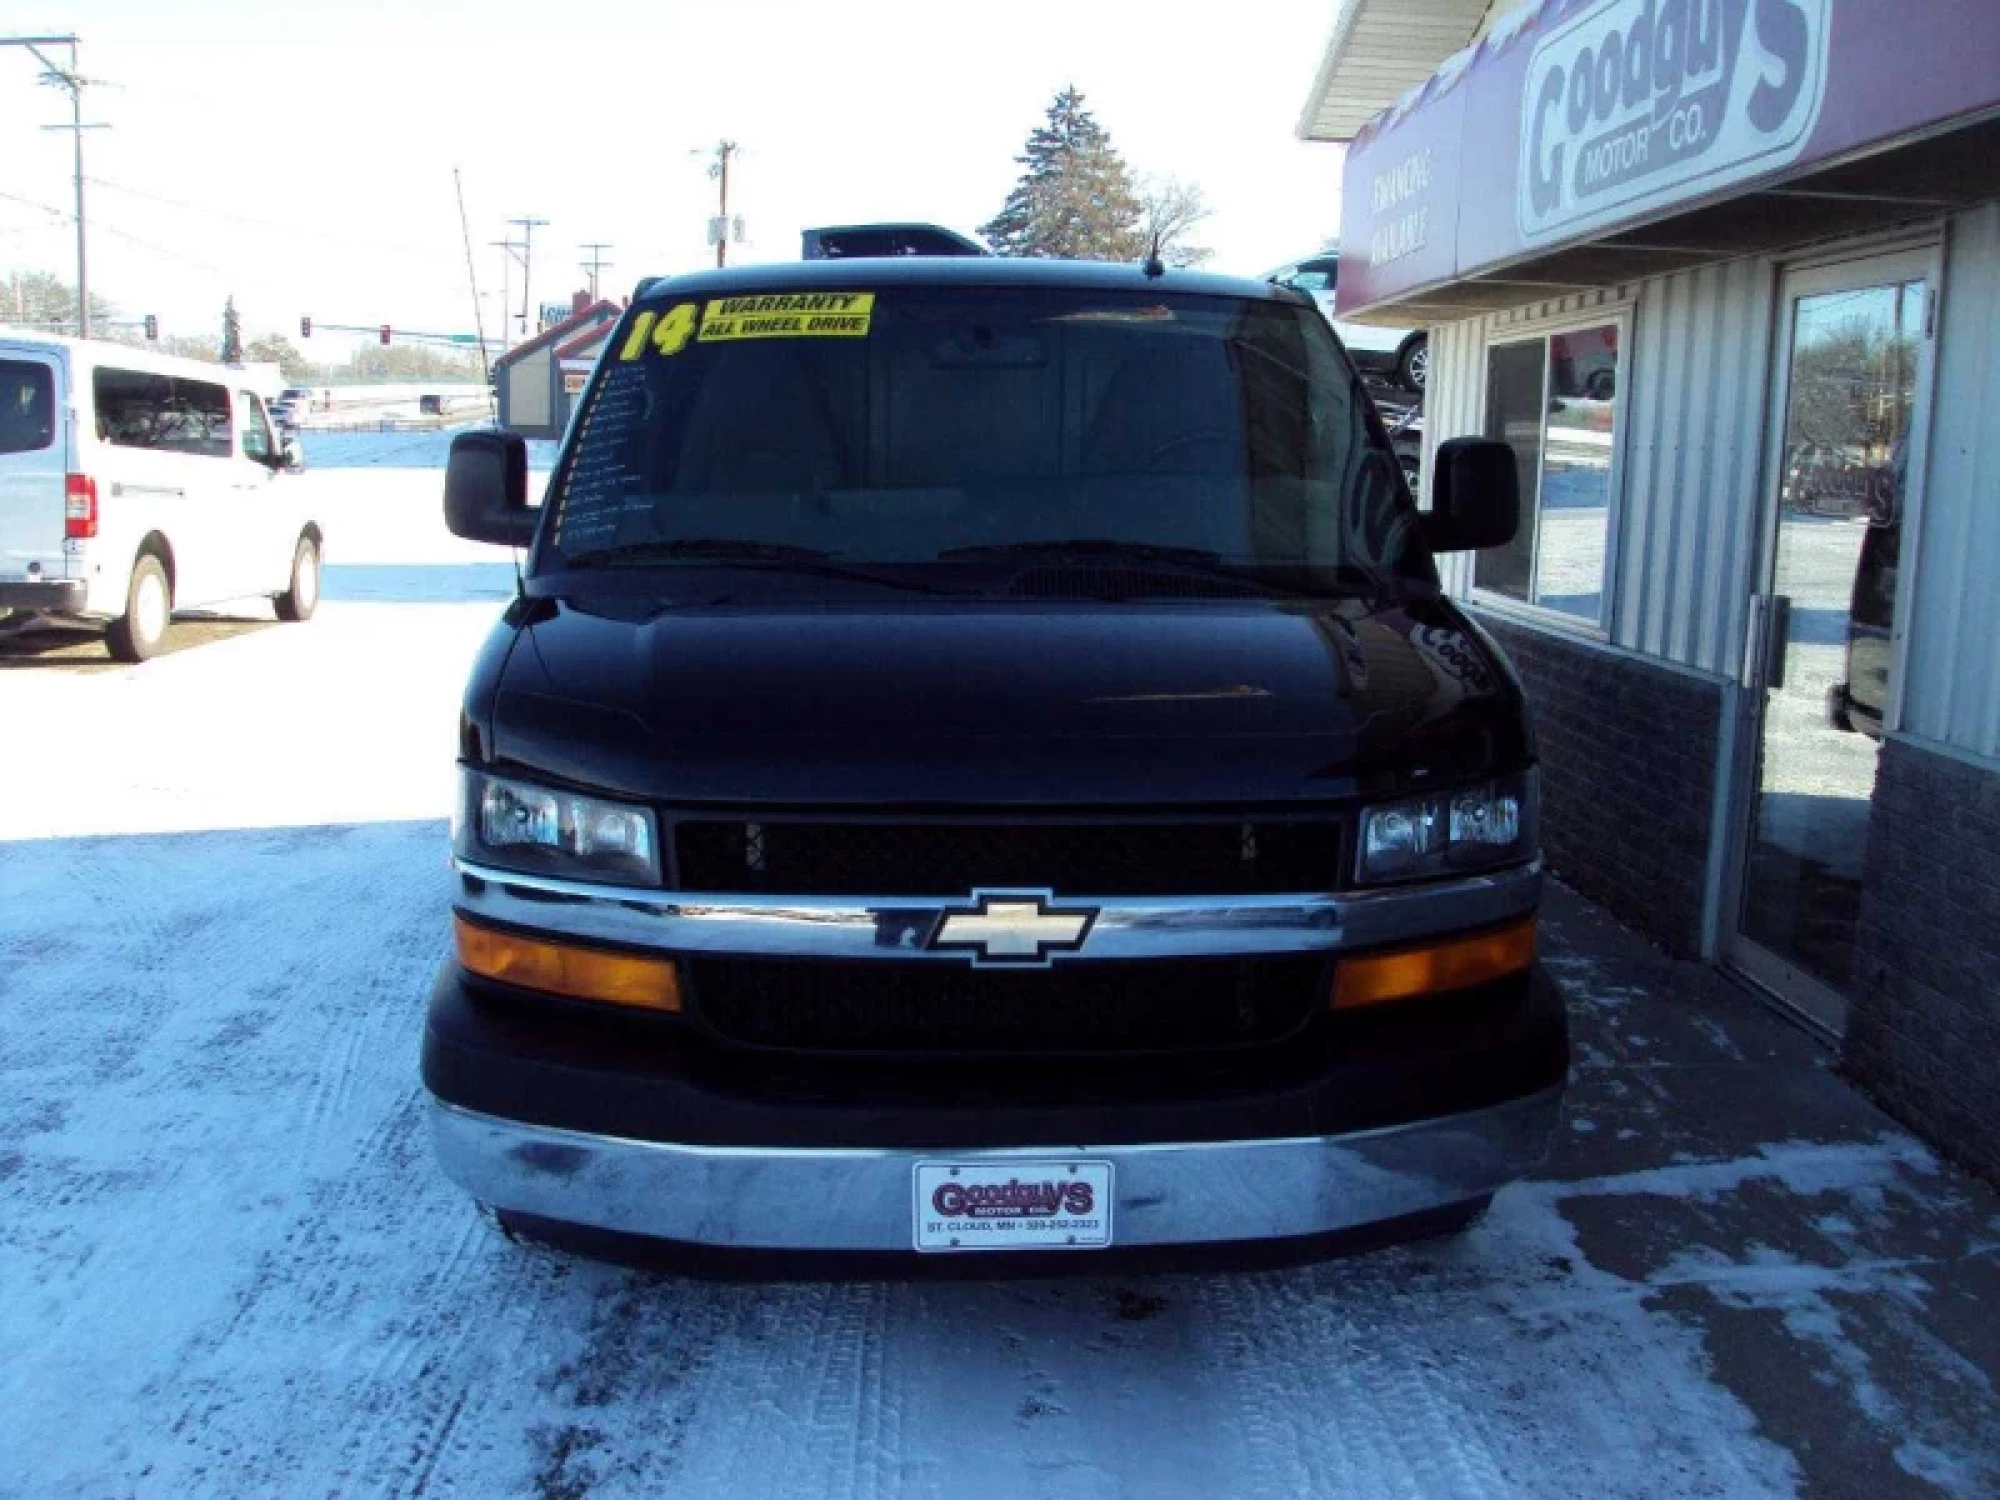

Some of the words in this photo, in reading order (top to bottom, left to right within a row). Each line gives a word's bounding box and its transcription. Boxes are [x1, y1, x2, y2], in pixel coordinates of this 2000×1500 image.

[1584, 126, 1649, 185] MOTOR
[1669, 103, 1706, 151] CO.
[719, 294, 857, 315] WARRANTY
[619, 302, 698, 362] 14
[702, 320, 735, 337] ALL
[740, 317, 801, 334] WHEEL
[807, 315, 866, 332] DRIVE
[997, 1219, 1016, 1231] MN
